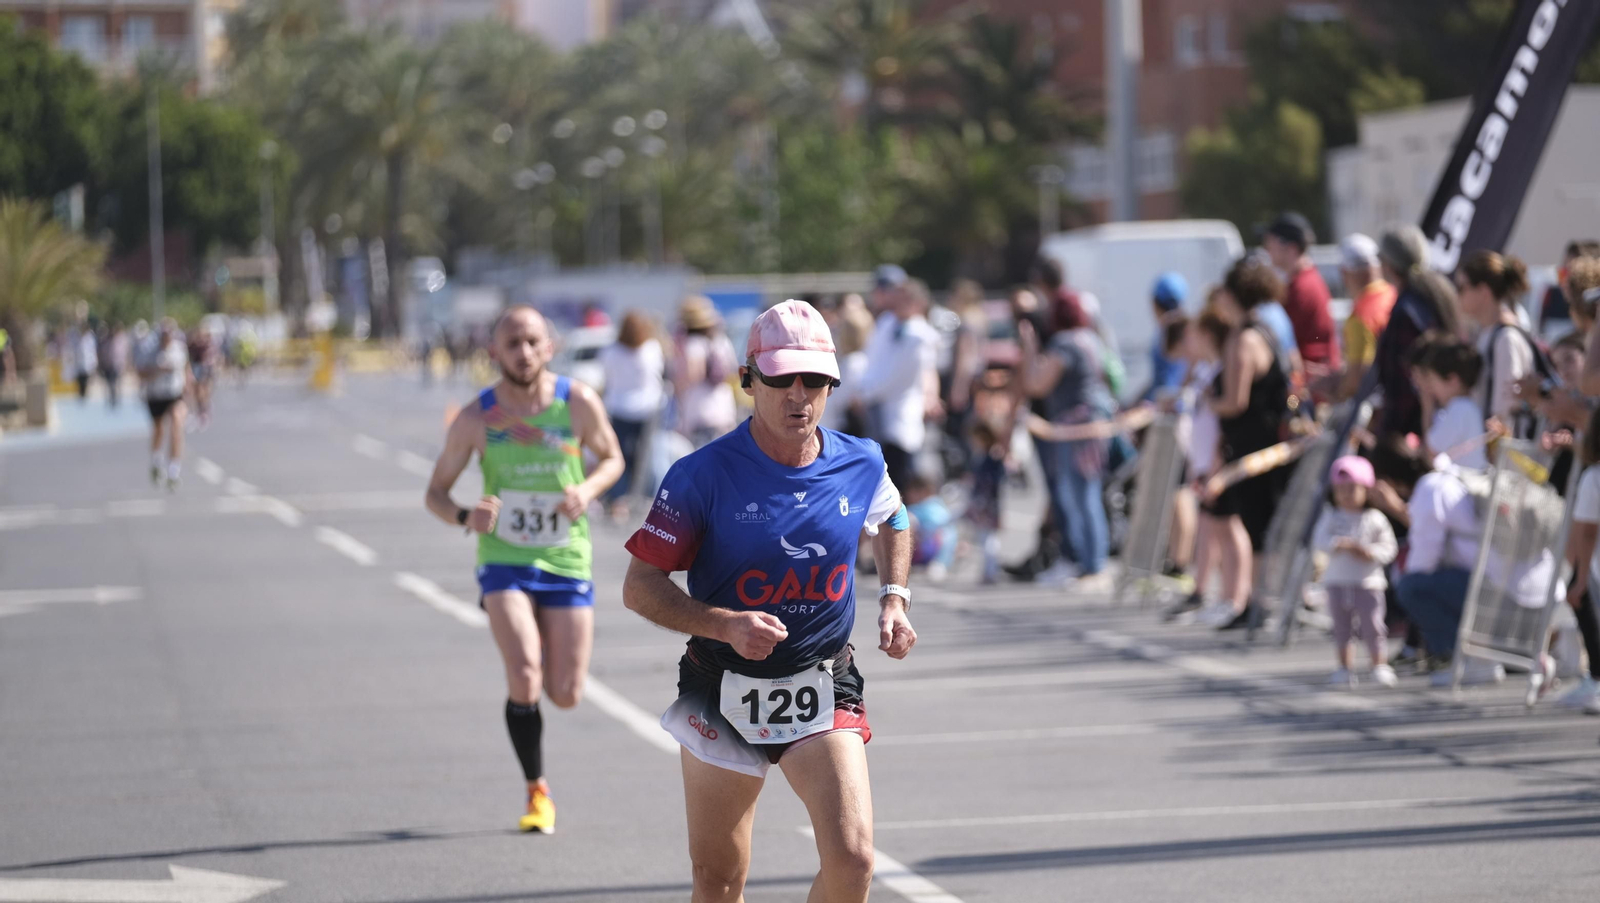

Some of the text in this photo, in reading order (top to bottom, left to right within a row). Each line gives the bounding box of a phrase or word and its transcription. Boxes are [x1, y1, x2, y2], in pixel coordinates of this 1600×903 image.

[511, 508, 558, 534] 331
[734, 512, 771, 521] SPIRAL
[736, 563, 849, 607] GALO
[741, 686, 819, 724] 129
[688, 715, 718, 741] GALO
